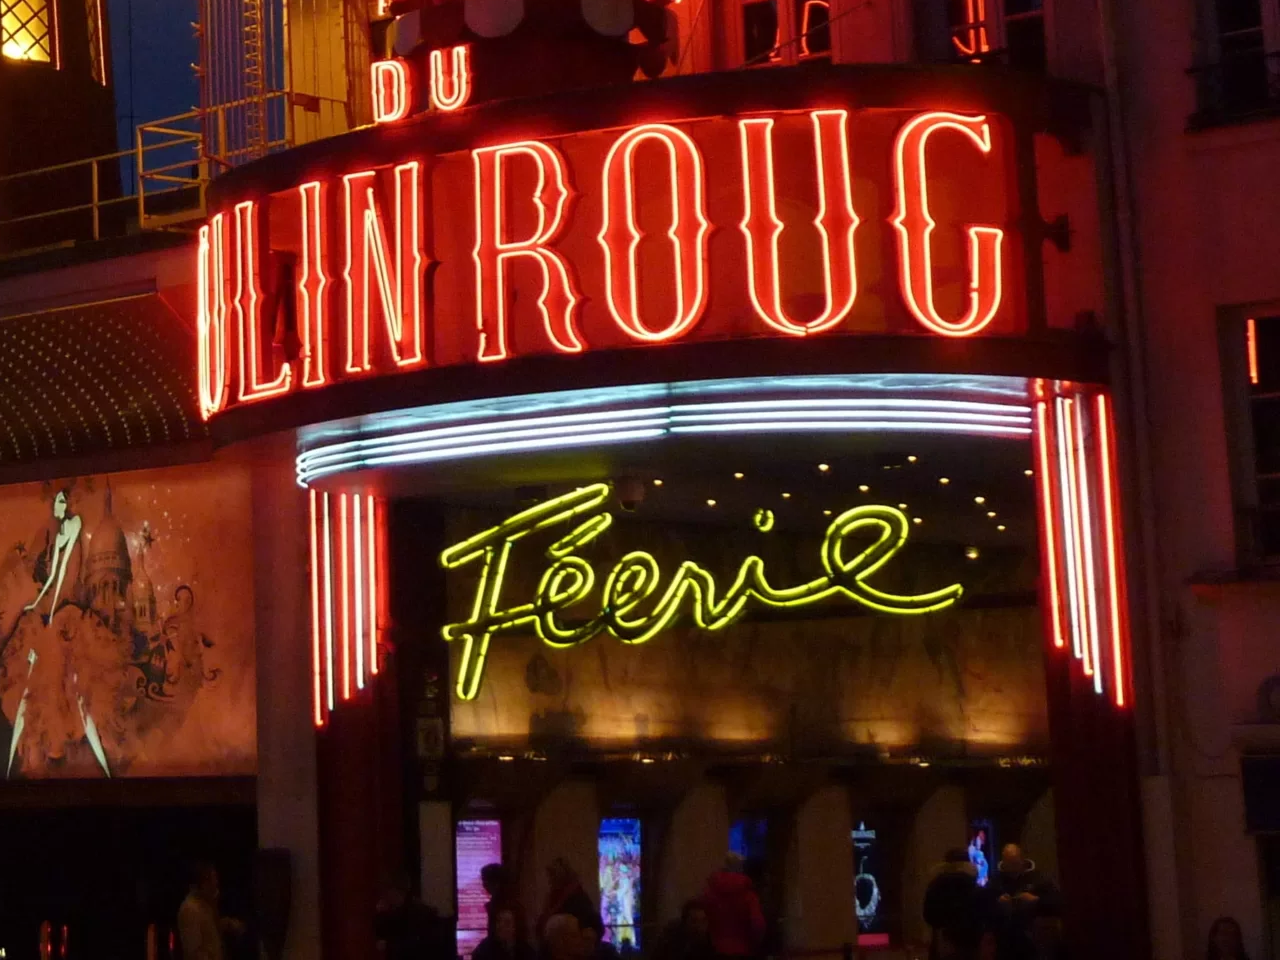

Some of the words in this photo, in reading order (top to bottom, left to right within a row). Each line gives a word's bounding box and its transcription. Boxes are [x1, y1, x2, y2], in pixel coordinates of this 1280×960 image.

[371, 45, 470, 123] DU
[472, 109, 1004, 362] ROUG
[441, 483, 964, 700] Féerie
